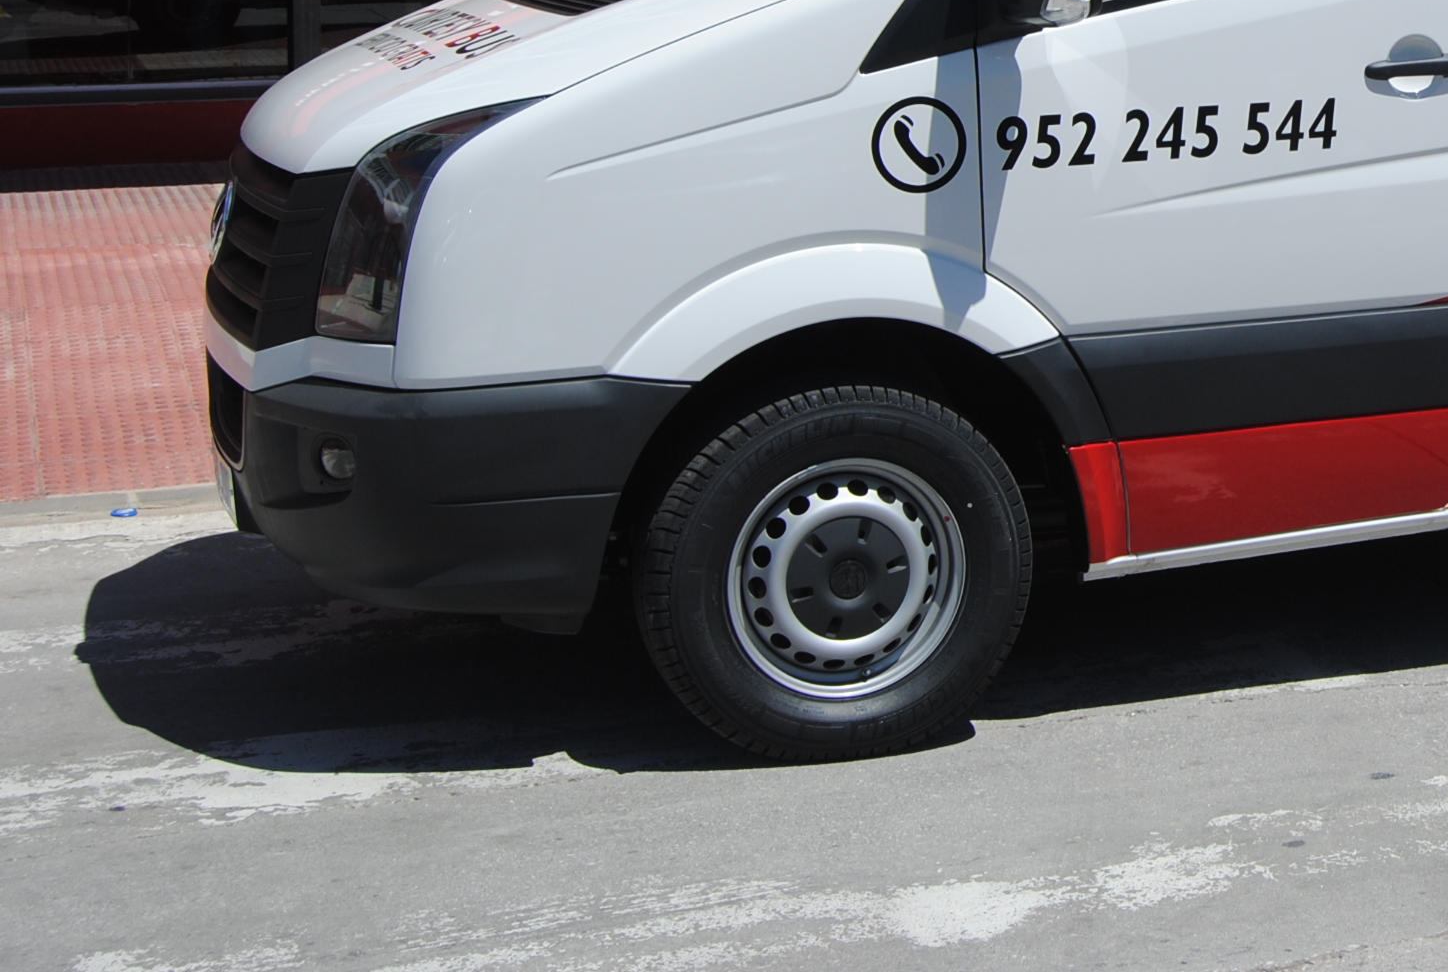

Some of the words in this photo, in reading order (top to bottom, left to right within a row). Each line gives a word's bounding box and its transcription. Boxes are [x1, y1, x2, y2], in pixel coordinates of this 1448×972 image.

[444, 25, 523, 60] BUS
[995, 112, 1097, 171] 952
[1121, 104, 1220, 164] 245
[1242, 97, 1338, 155] 544
